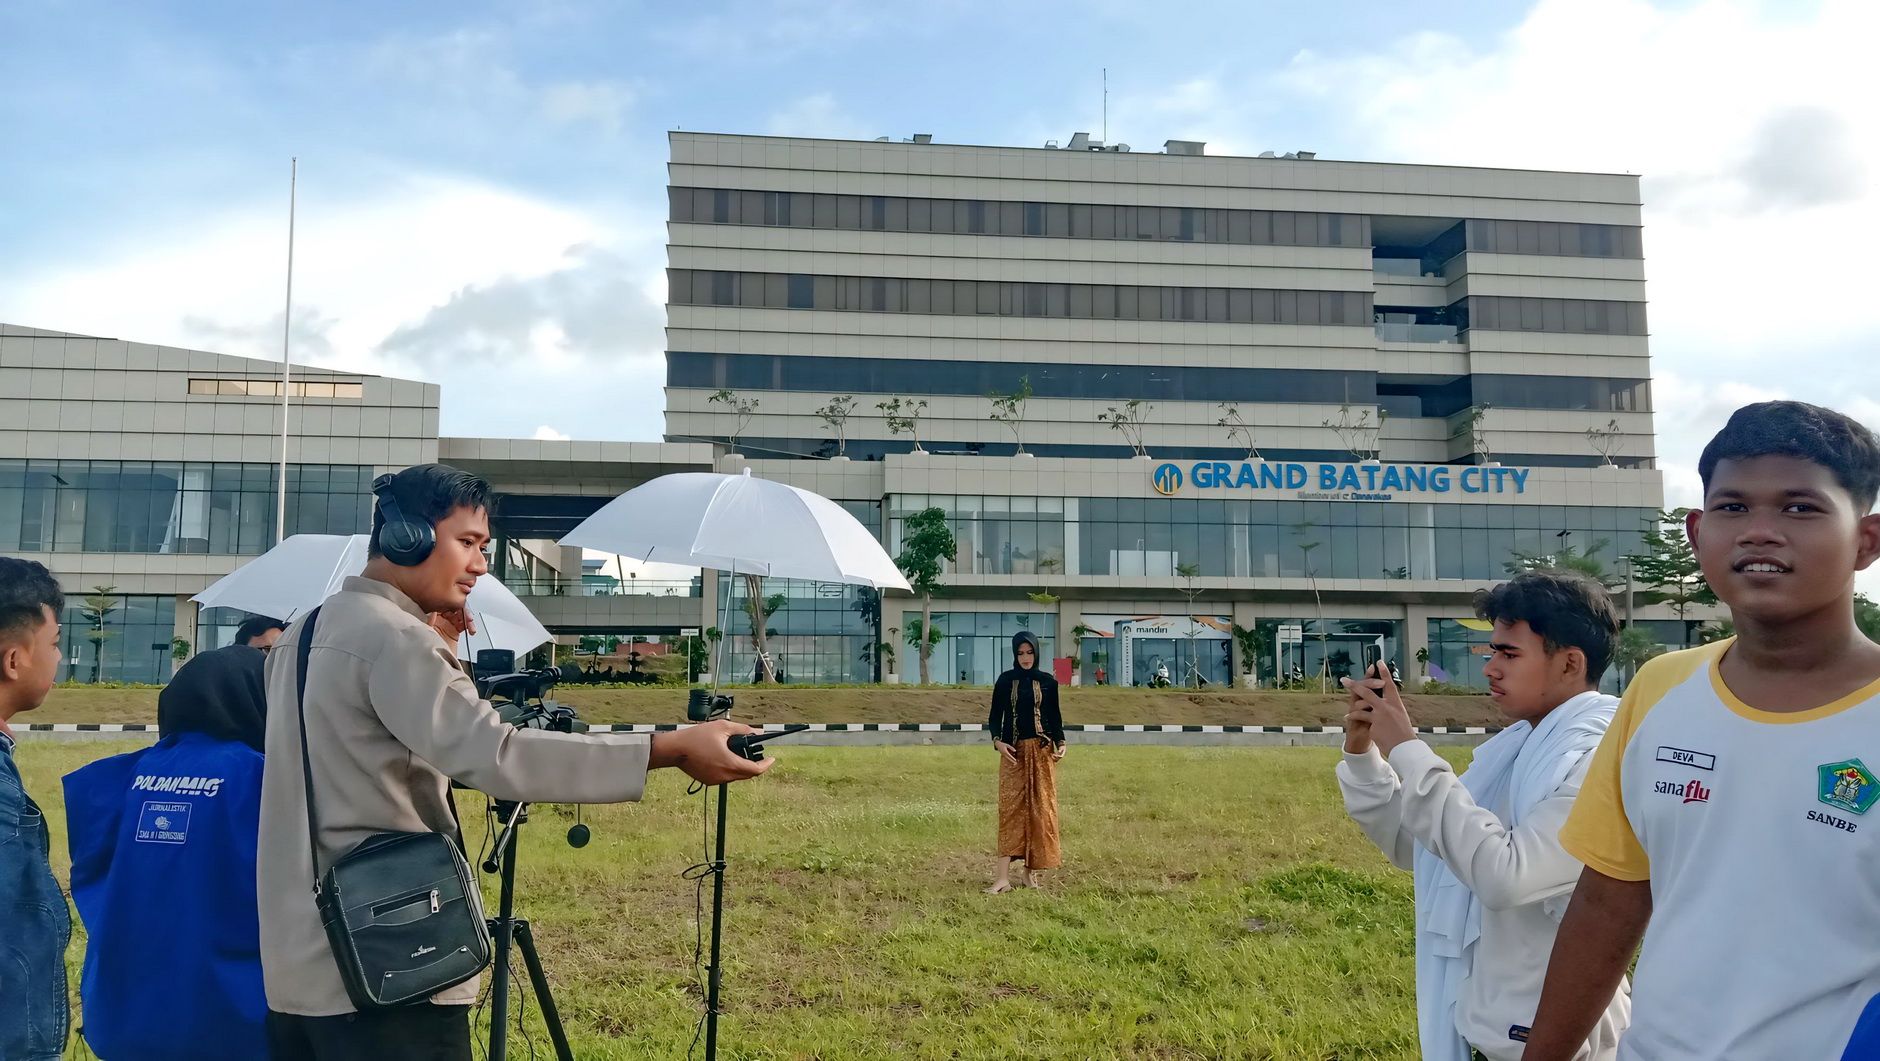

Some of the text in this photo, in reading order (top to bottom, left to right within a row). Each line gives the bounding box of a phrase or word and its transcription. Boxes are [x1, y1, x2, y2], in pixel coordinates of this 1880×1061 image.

[1191, 462, 1529, 493] GRAND BATANG CITY
[1136, 626, 1168, 634] mandiri
[1672, 750, 1695, 763] DEVA
[1653, 779, 1711, 803] sanaflu
[1806, 810, 1857, 833] SANBE
